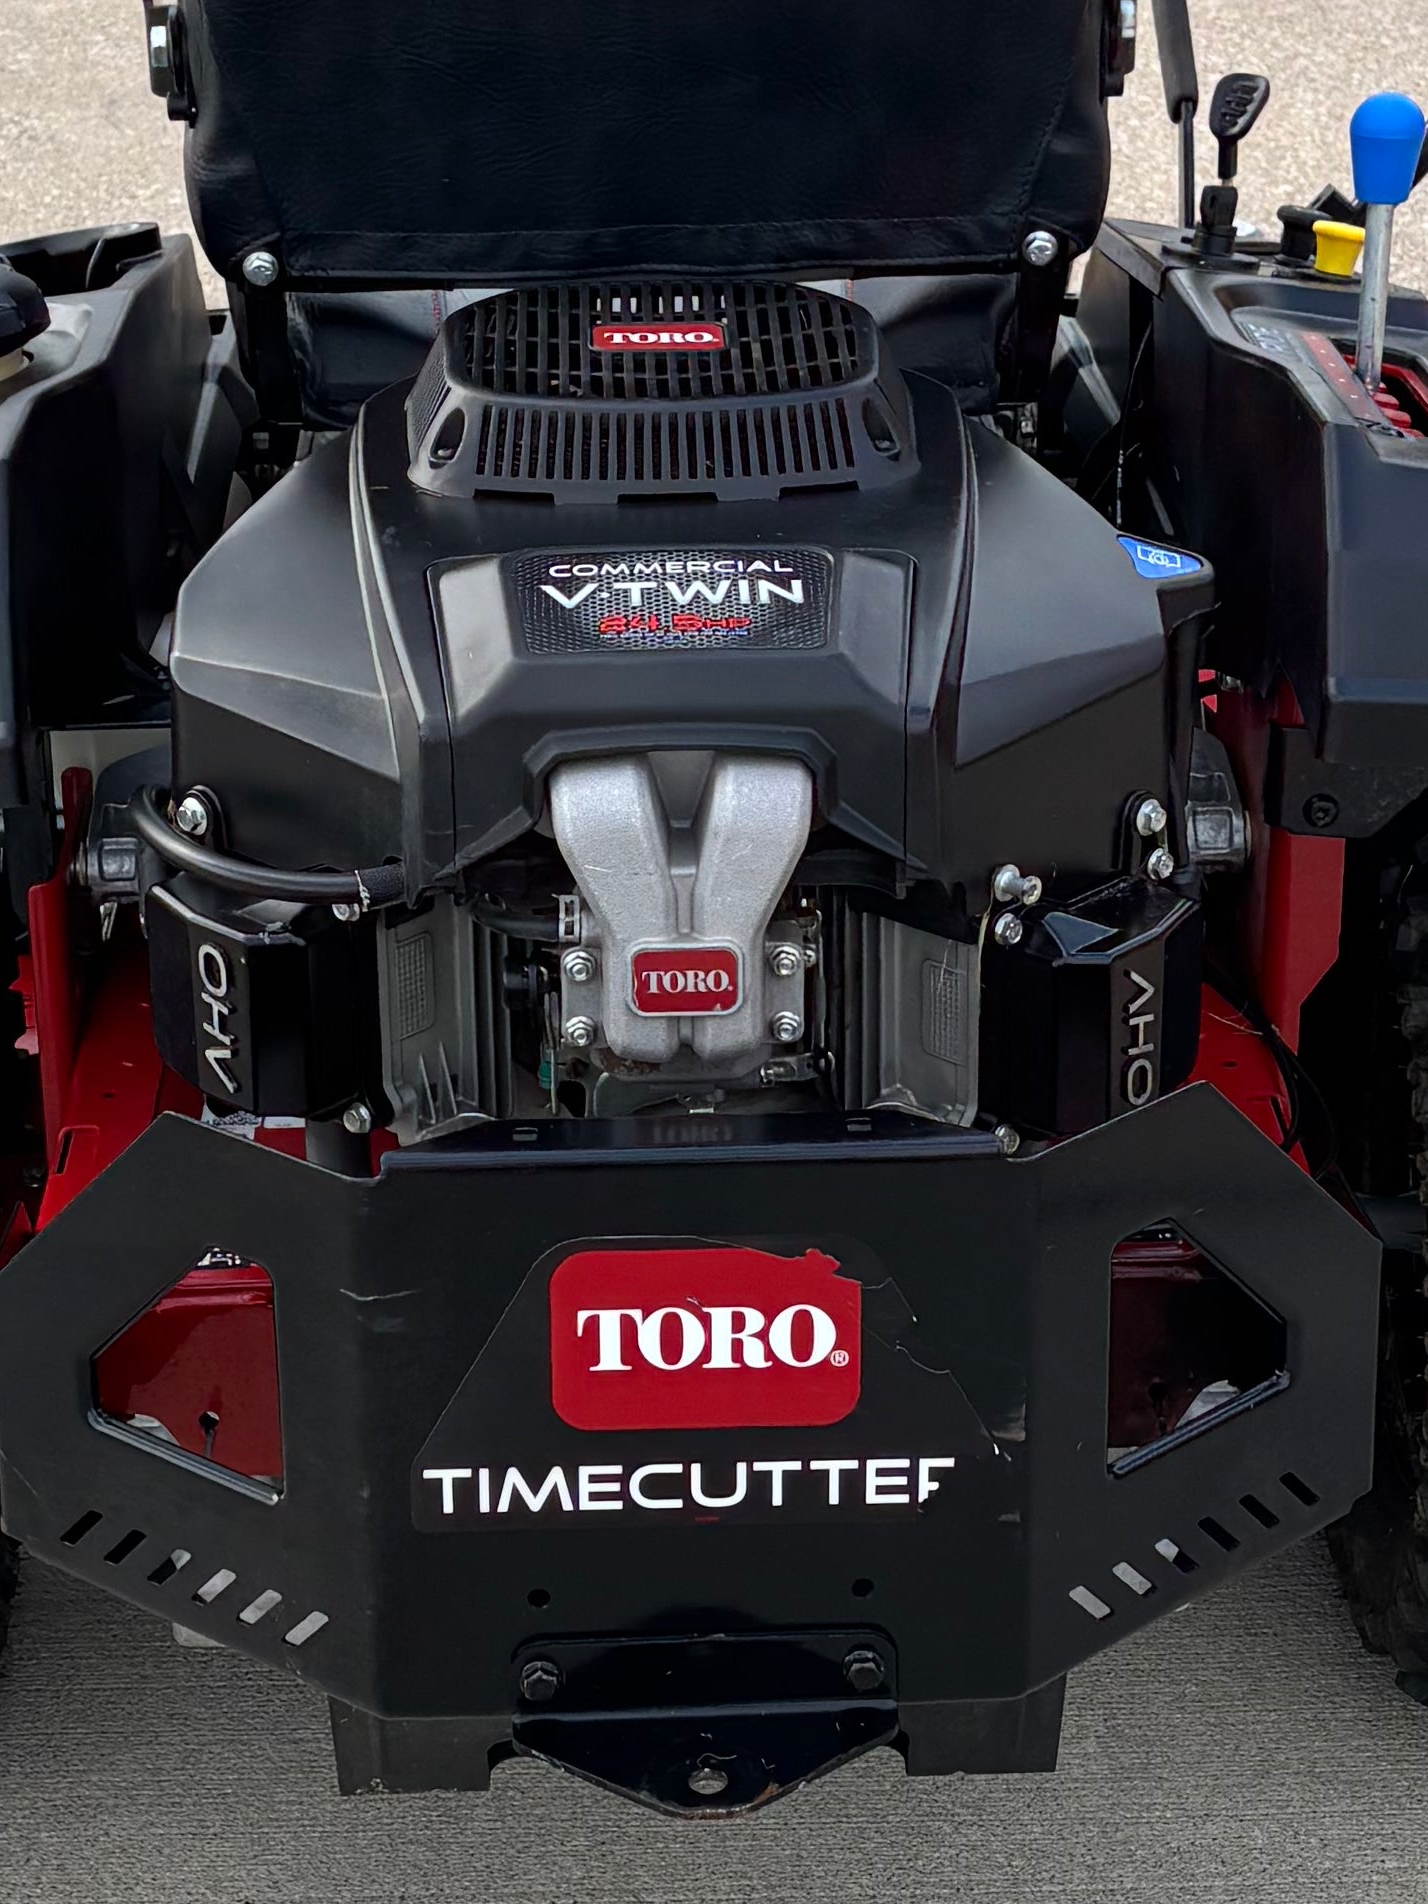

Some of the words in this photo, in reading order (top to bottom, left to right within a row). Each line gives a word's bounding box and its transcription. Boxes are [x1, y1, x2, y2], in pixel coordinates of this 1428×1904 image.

[548, 559, 794, 578] COMMERCIAL
[197, 943, 238, 1095] OHV
[1125, 968, 1156, 1107] OHV
